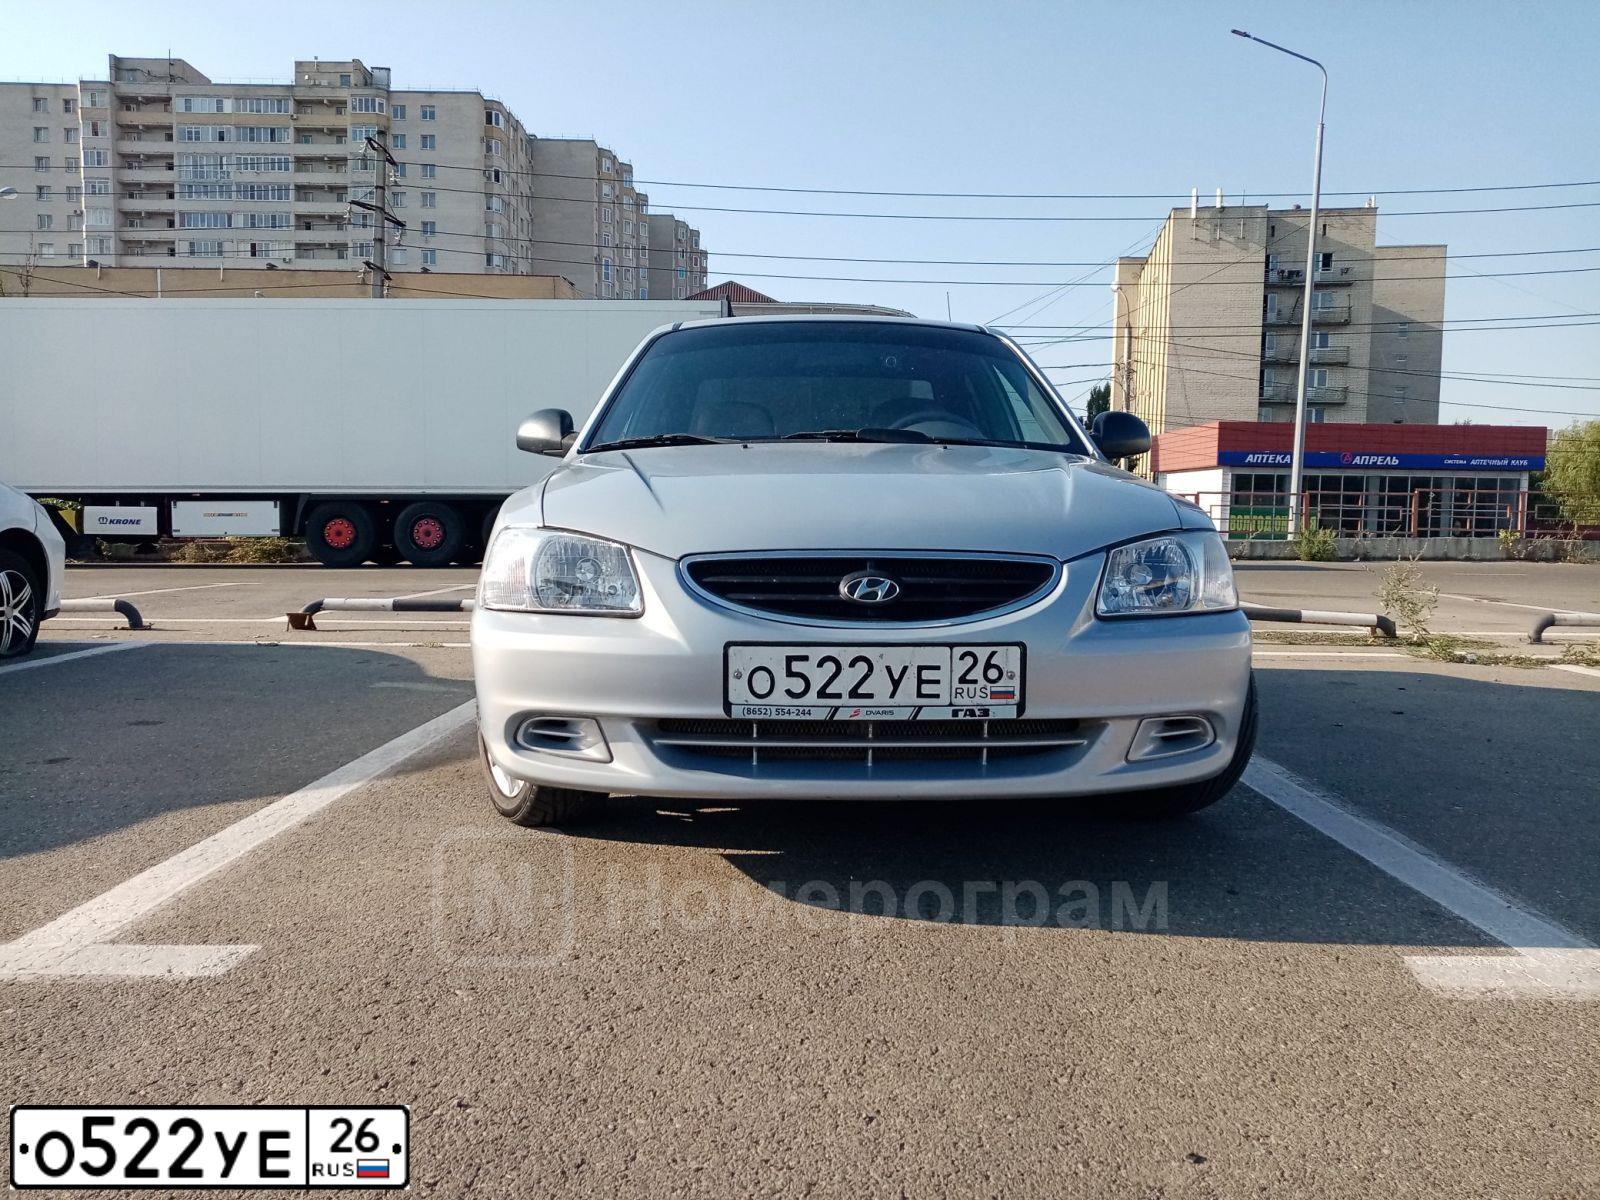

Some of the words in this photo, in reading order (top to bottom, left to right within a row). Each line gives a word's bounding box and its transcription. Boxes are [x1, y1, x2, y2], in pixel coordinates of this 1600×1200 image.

[1245, 453, 1291, 464] АПТЕКА
[1352, 455, 1399, 466] АПРЕЛЬ
[1470, 458, 1509, 466] АПТЕЧНЫЙ
[747, 654, 941, 700] О522УЕ
[957, 651, 1004, 685] 26
[954, 687, 988, 700] RUS
[742, 707, 773, 717] (8652)
[775, 708, 812, 717] 554-244
[951, 708, 990, 718] ГАЗ
